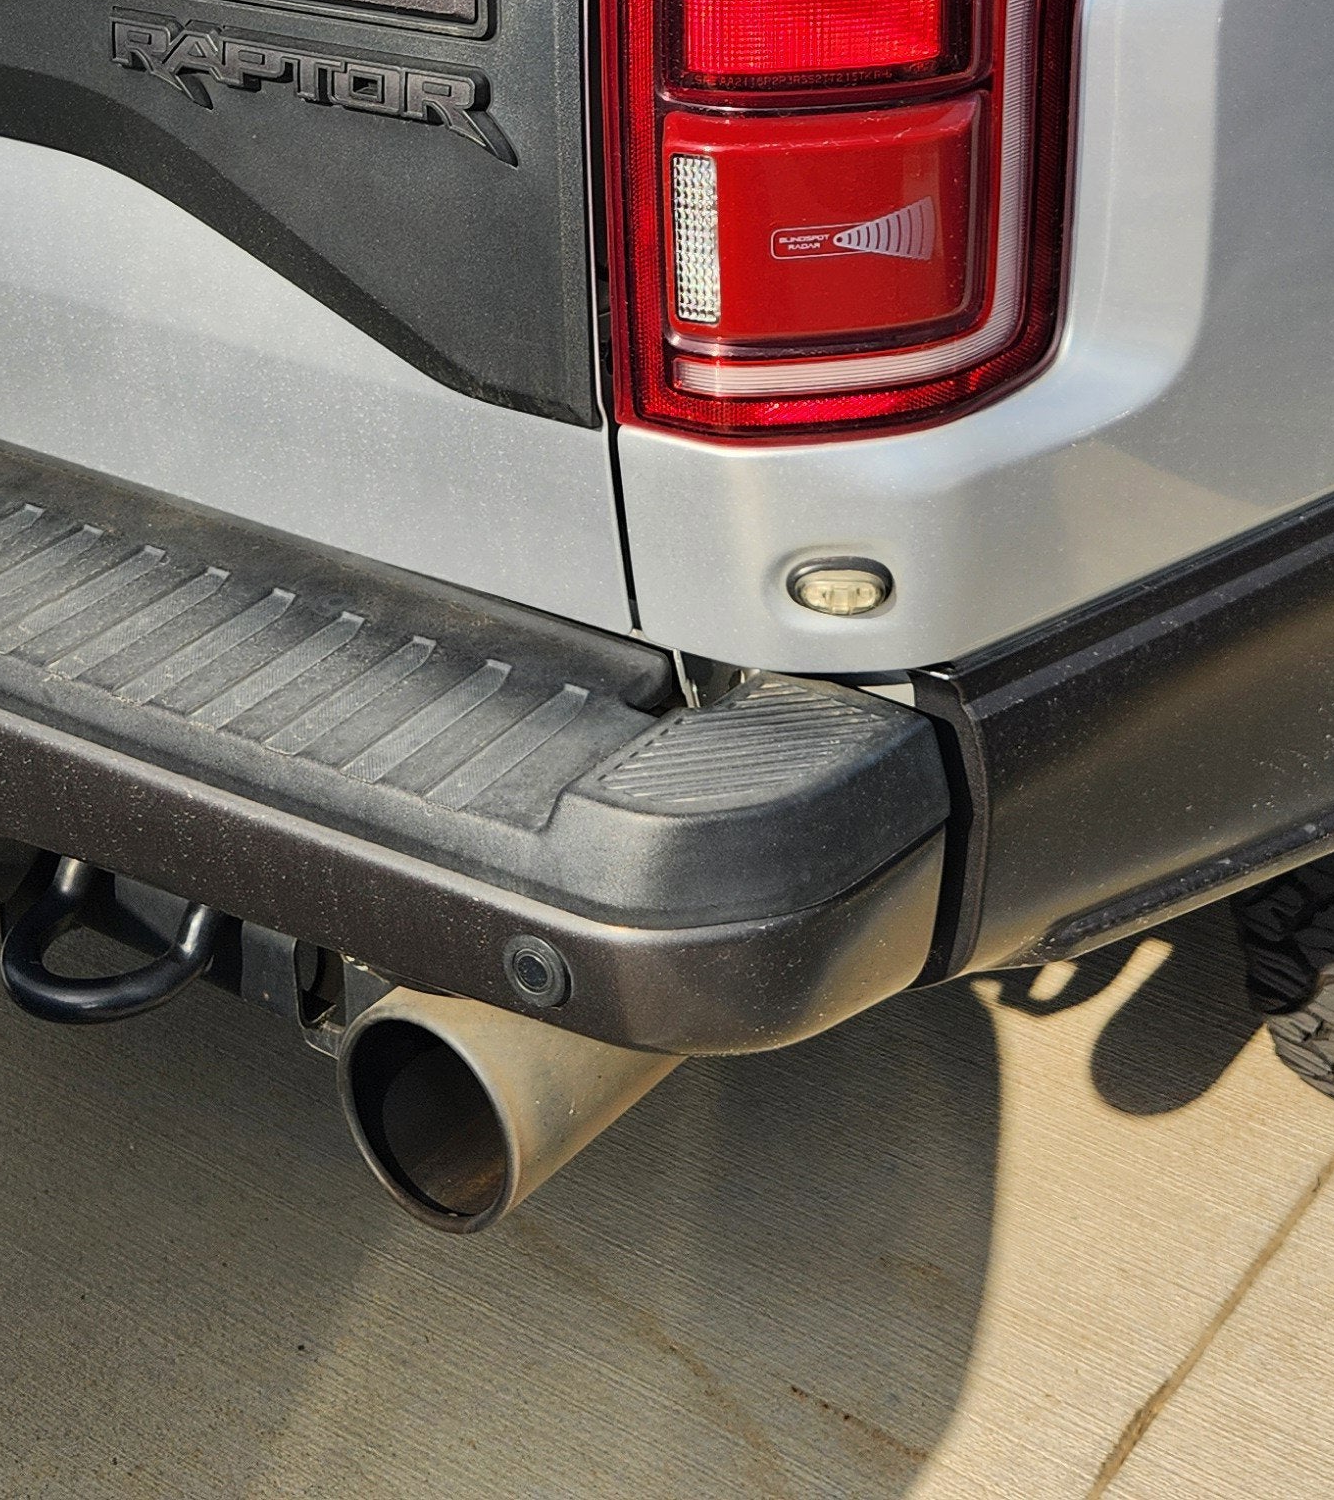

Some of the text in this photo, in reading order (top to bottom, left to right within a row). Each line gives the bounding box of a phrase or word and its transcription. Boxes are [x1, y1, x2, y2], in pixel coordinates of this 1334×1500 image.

[111, 7, 519, 168] RAPTOR
[778, 233, 831, 245] BLINDSPOT
[787, 242, 821, 251] RADAR
